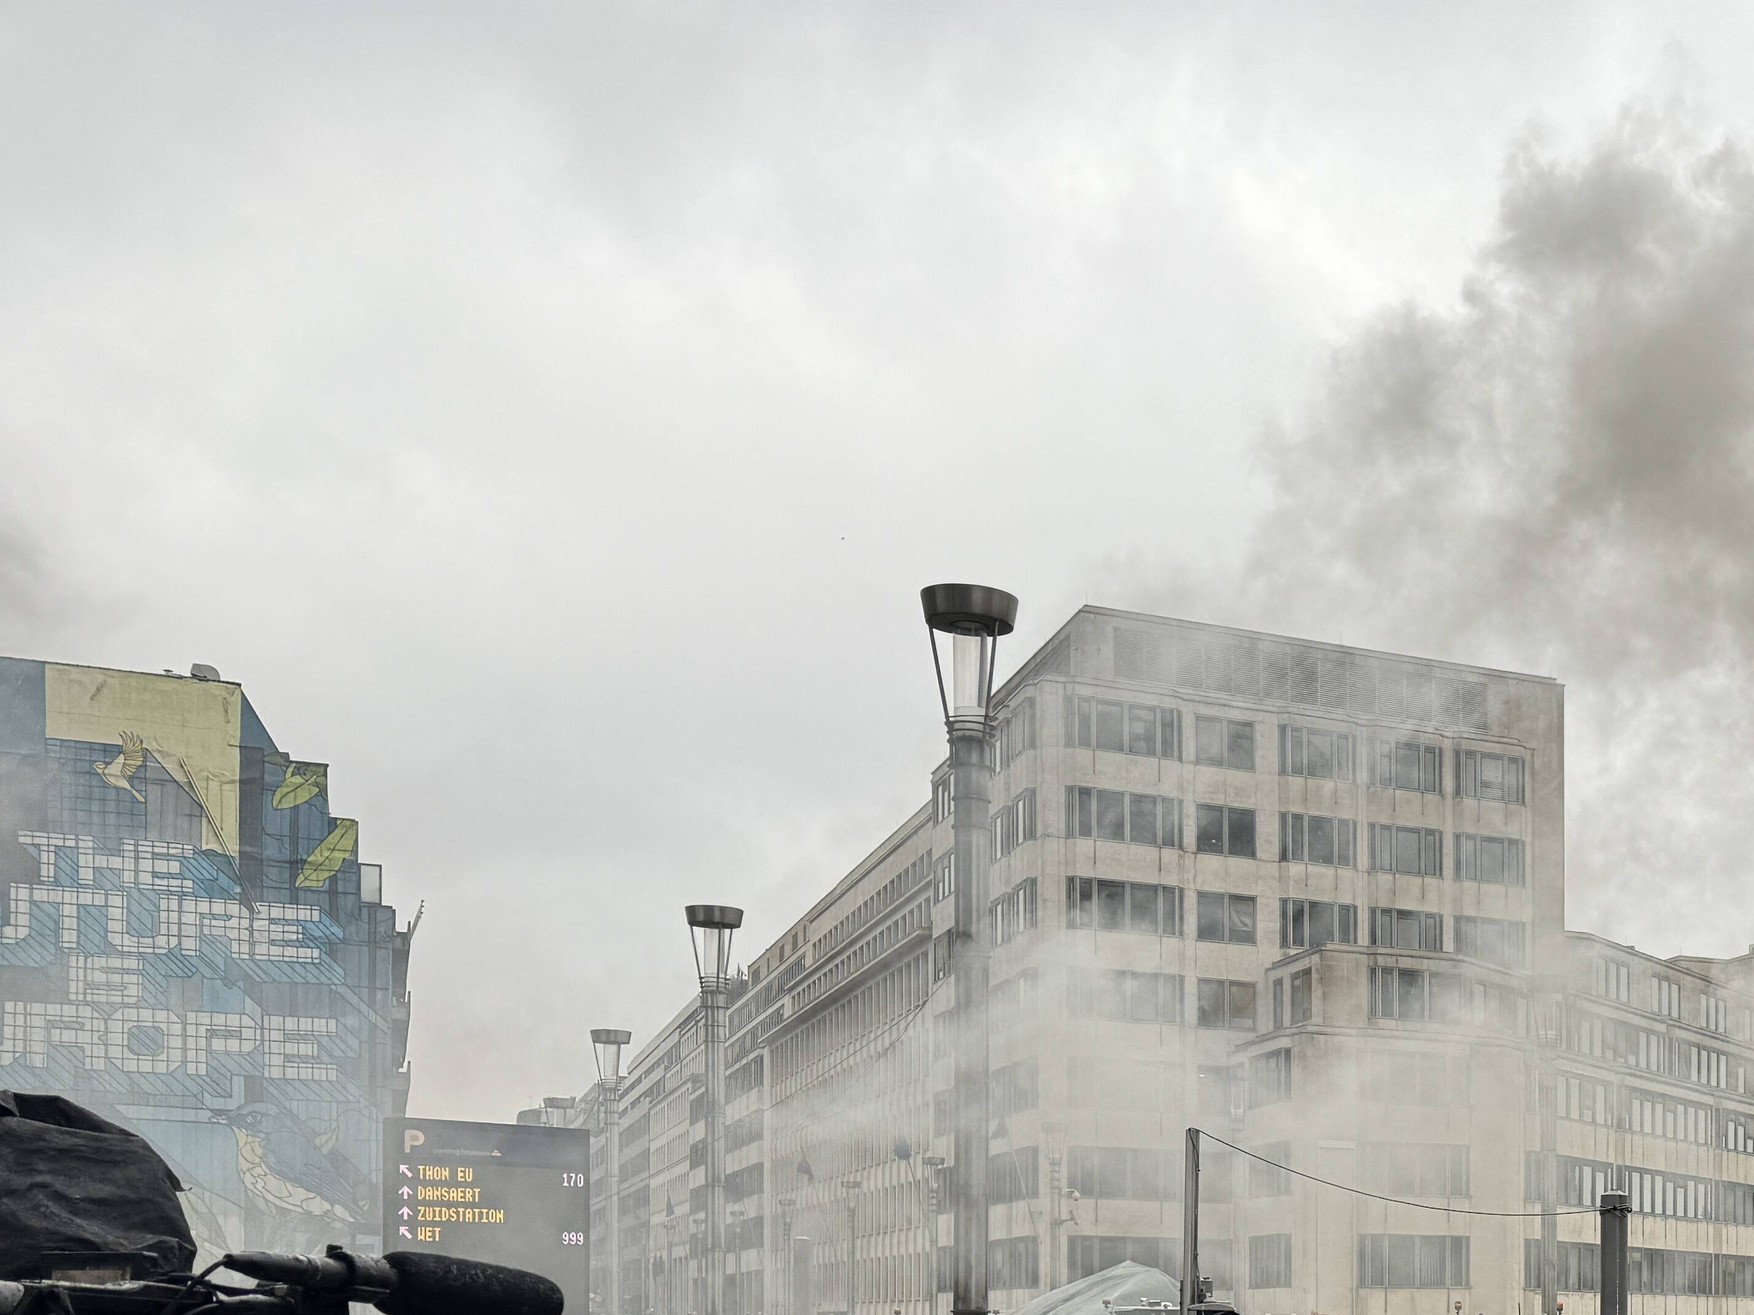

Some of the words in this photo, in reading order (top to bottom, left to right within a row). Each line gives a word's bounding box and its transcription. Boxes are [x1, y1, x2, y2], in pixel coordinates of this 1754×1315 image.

[18, 830, 195, 890] THE
[417, 1165, 450, 1181] THON
[457, 1167, 473, 1182] EU
[562, 1173, 584, 1187] 170
[417, 1186, 480, 1202] DANSAERT
[417, 1206, 504, 1223] ZUIDSTATION
[417, 1227, 441, 1242] WET
[562, 1232, 584, 1245] 999
